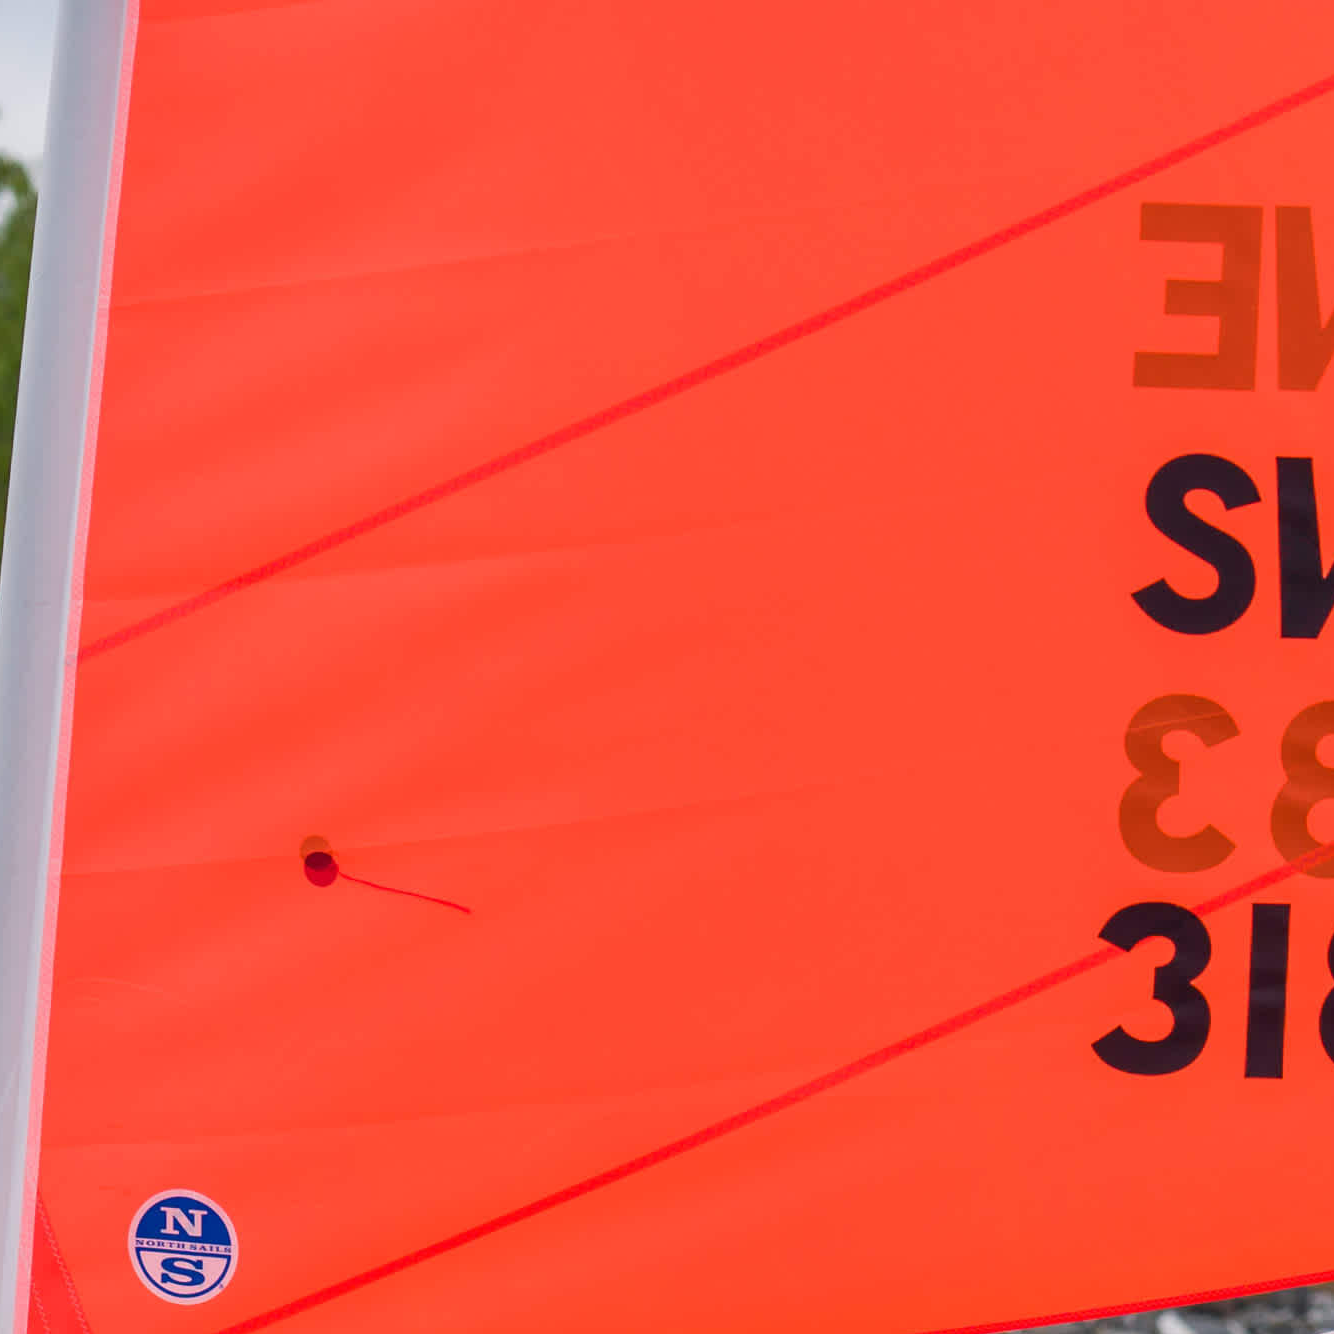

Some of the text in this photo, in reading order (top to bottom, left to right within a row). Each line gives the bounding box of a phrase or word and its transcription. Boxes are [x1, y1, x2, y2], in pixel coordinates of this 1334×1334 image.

[160, 1206, 208, 1237] N
[135, 1239, 232, 1253] NORTH SAILS
[160, 1256, 206, 1287] S
